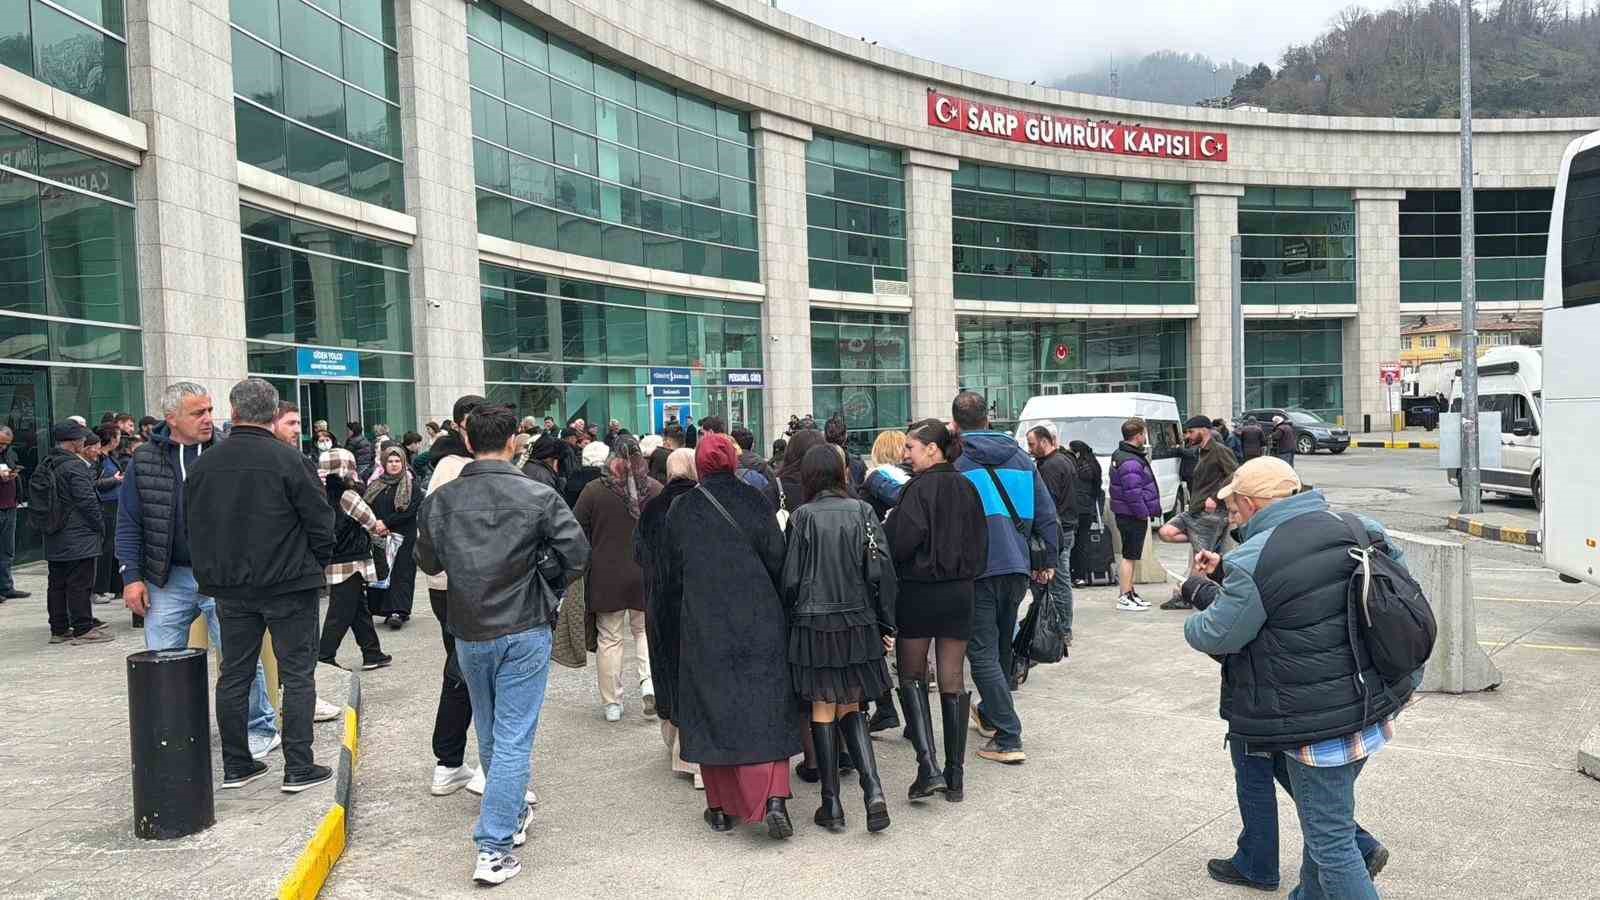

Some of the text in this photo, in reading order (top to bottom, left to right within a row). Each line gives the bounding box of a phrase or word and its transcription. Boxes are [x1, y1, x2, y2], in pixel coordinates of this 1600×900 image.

[967, 107, 1190, 156] SARP GÜMRÜK KAPISI
